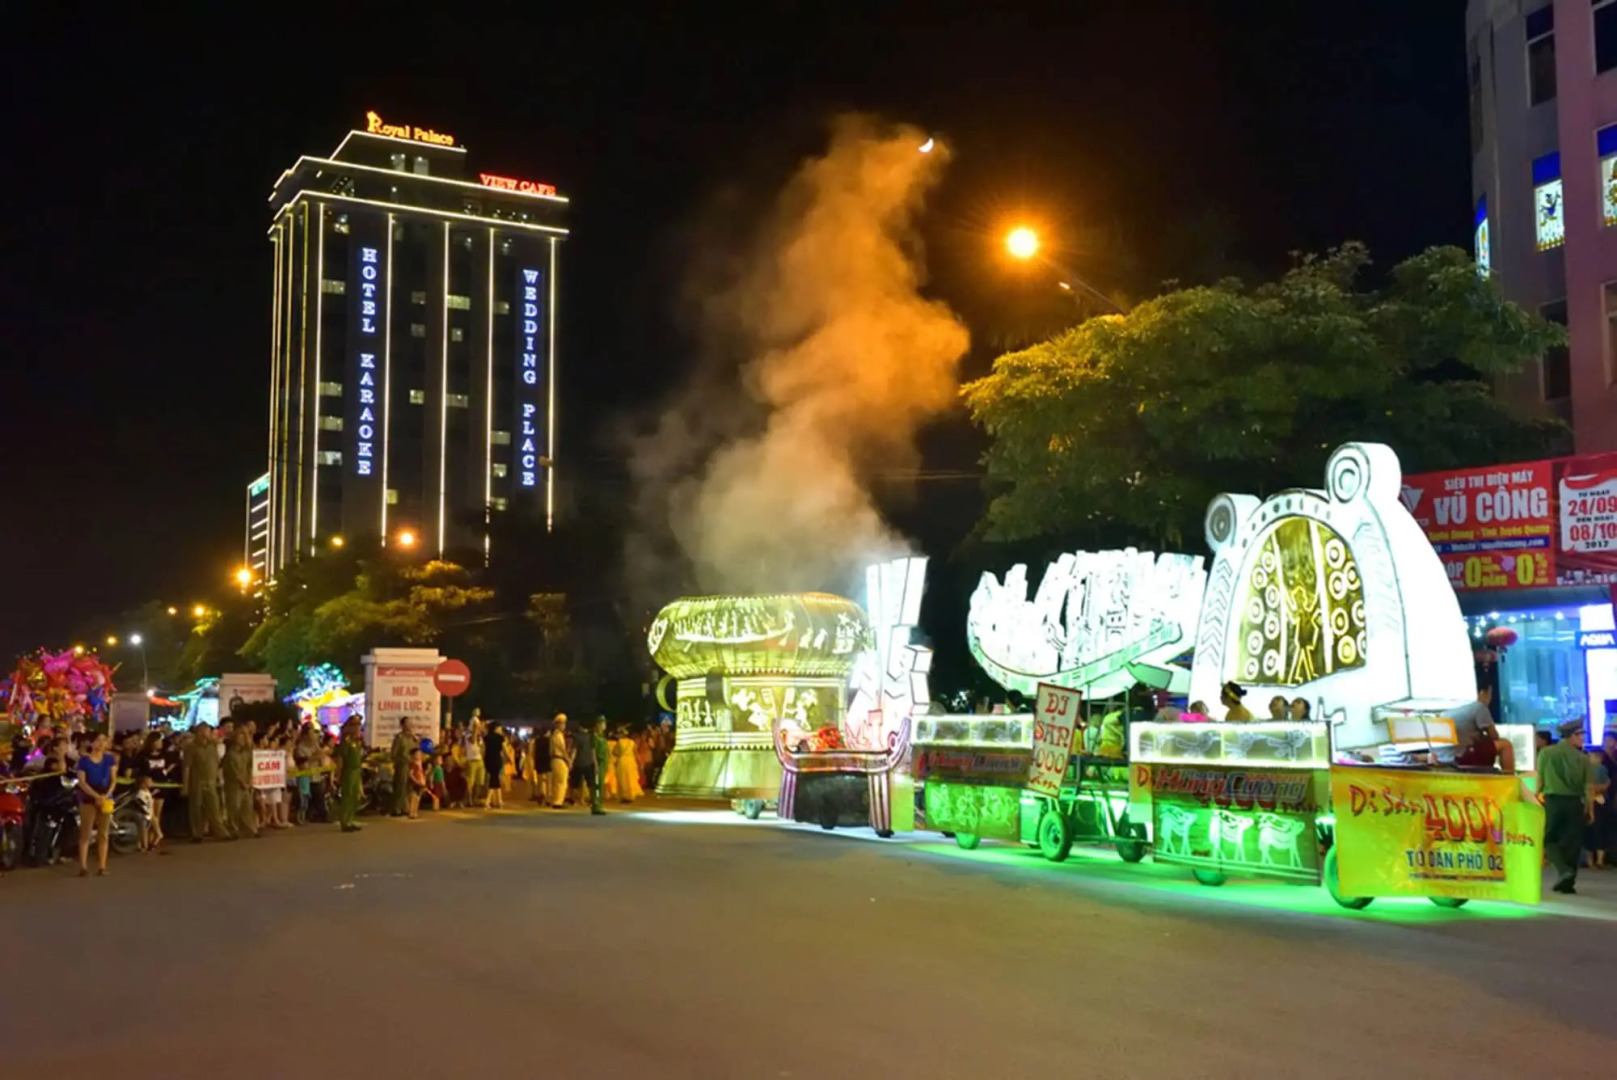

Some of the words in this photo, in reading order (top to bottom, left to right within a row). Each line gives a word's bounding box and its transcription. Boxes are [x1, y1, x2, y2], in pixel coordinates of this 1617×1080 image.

[366, 111, 410, 138] Royal
[414, 127, 454, 146] Palace
[480, 173, 517, 191] VIEW
[361, 247, 378, 333] HOTEL
[522, 269, 539, 385] WEDDING
[357, 353, 376, 475] KARAOKE
[521, 403, 536, 486] PLACE
[1433, 490, 1467, 525] VŨ
[1476, 485, 1548, 523] CÔNG
[1568, 496, 1617, 517] 24/09
[1569, 521, 1617, 542] 08/10
[392, 686, 419, 697] HEAD
[425, 701, 433, 711] 2
[1422, 793, 1504, 845] 4000
[1486, 854, 1504, 871] 02
